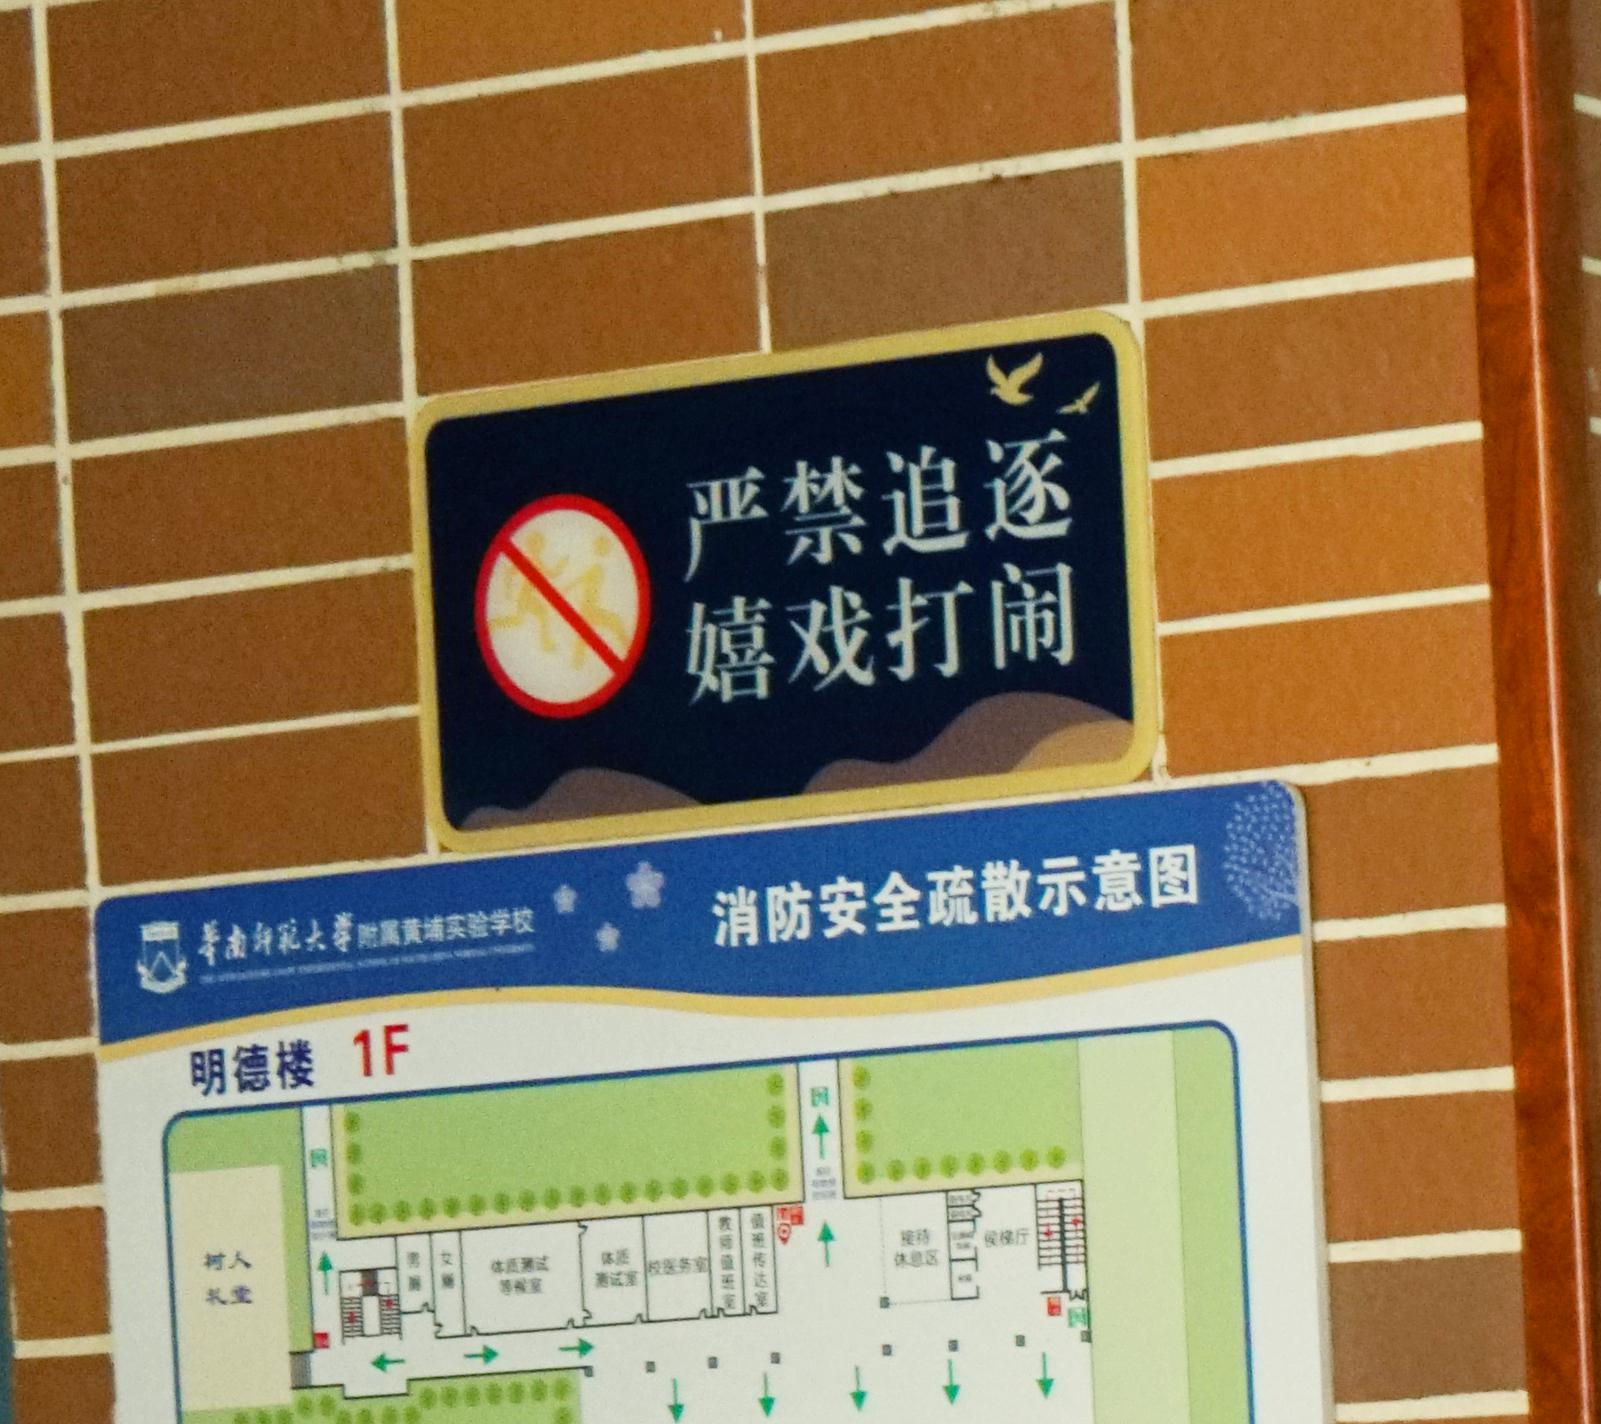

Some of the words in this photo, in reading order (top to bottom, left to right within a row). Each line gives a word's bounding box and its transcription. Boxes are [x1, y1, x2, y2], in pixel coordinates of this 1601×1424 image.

[683, 429, 1074, 583] 严禁追逐
[683, 561, 1075, 706] 嬉戏打闹
[712, 842, 1199, 948] 消防安全疏散示意图
[190, 1039, 316, 1096] 明德楼
[352, 1023, 411, 1078] 1F
